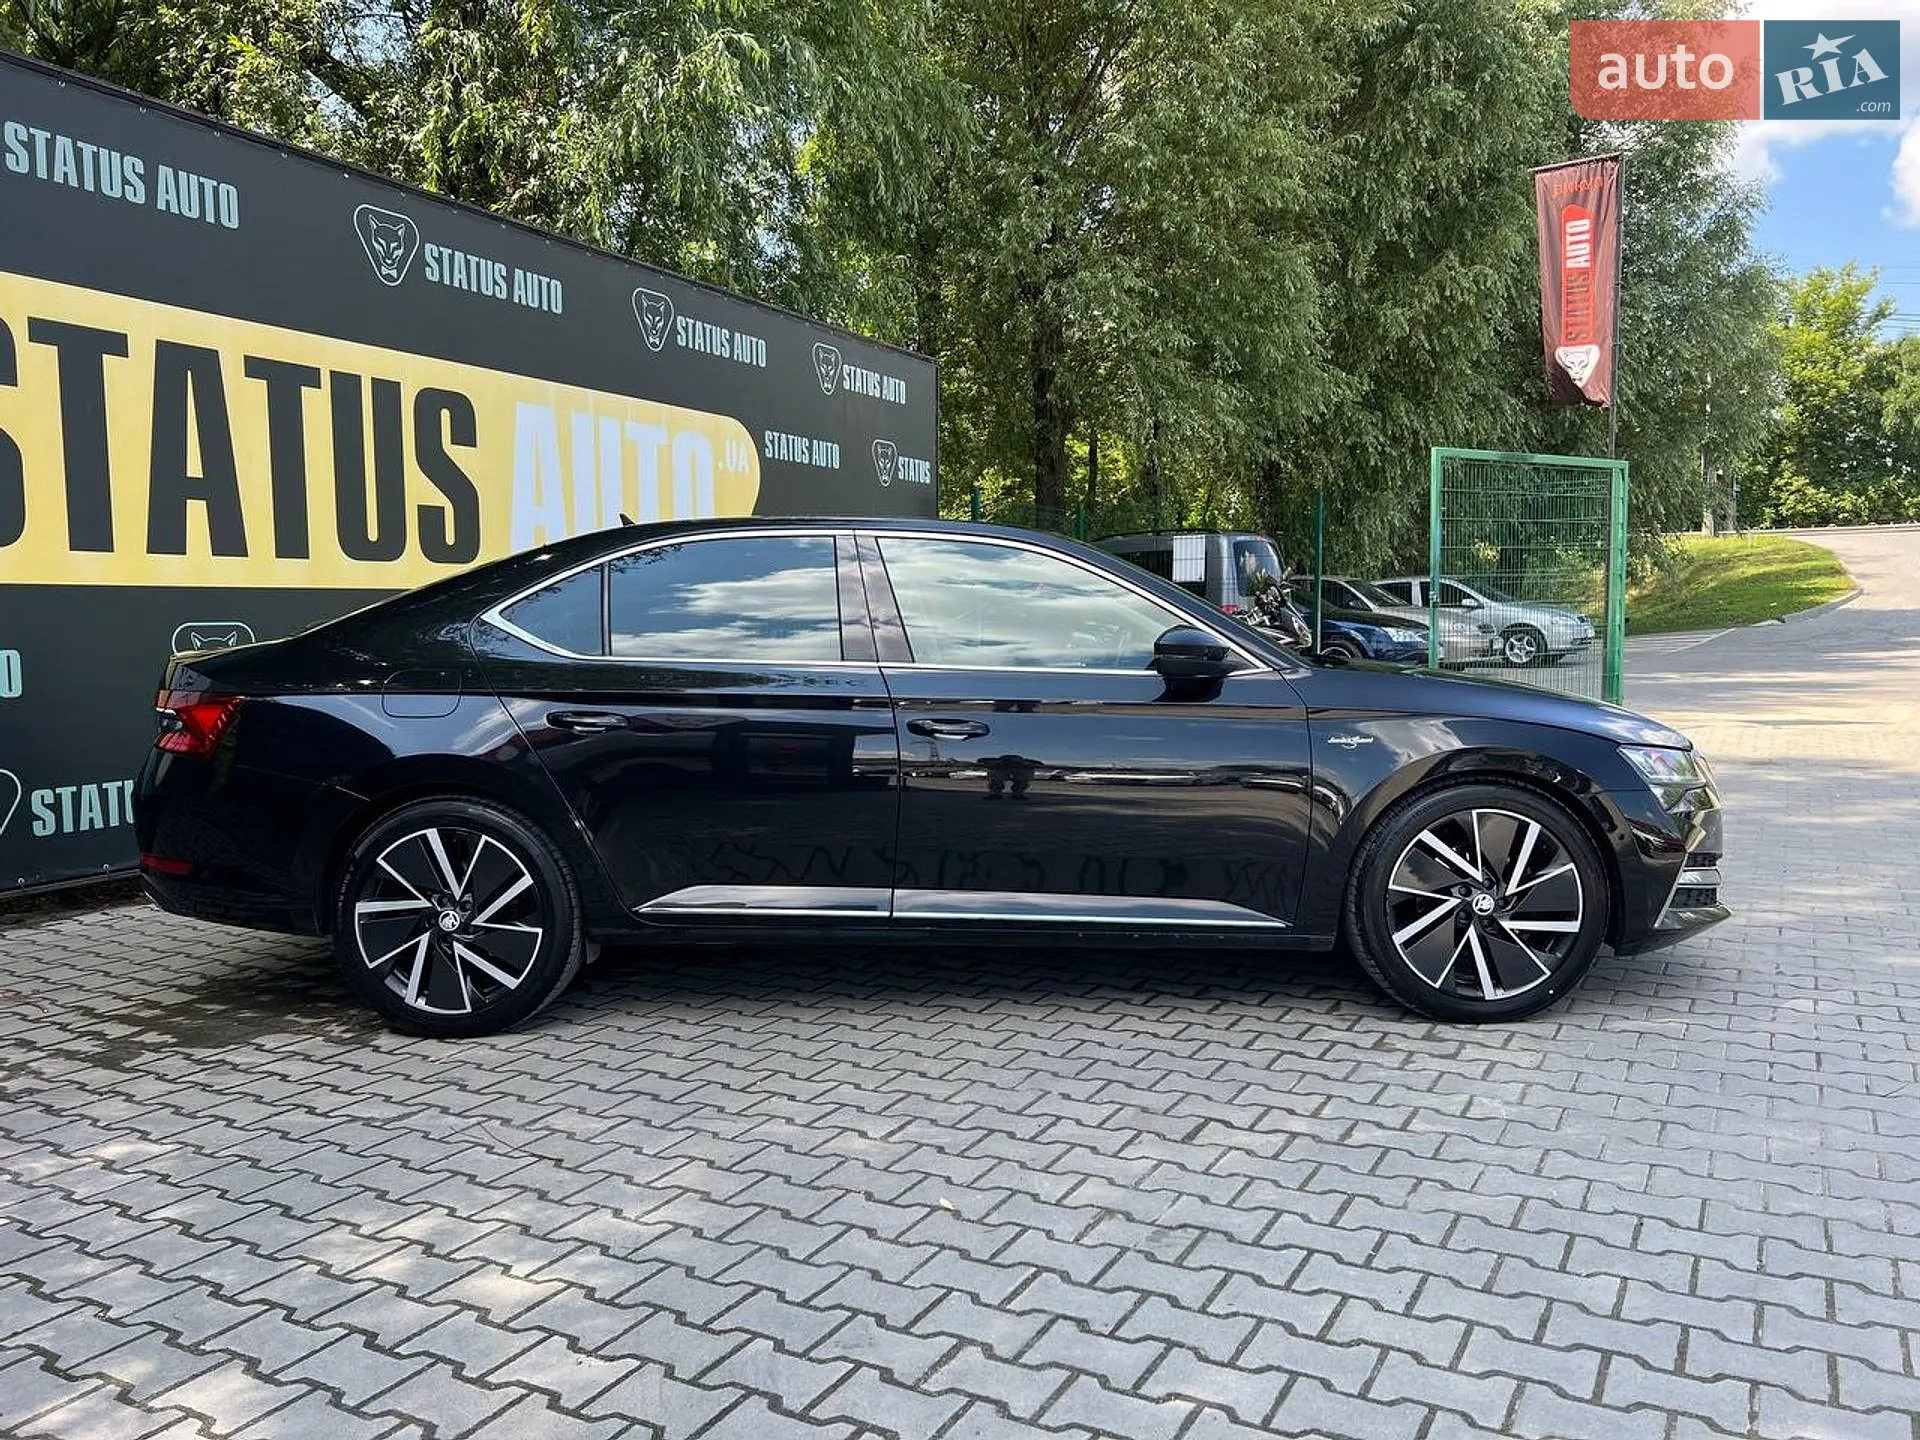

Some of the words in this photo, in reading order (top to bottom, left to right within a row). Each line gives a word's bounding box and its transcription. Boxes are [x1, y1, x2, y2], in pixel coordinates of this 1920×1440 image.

[4, 121, 146, 204] STATUS
[157, 165, 239, 230] AUTO
[1566, 219, 1591, 269] AUTO
[424, 243, 507, 299] STATUS
[513, 269, 563, 315] AUTO
[676, 315, 731, 356] STATUS
[733, 333, 767, 368] AUTO
[842, 364, 880, 398] STATUS
[882, 377, 906, 404] AUTO
[765, 430, 810, 464] STATUS
[811, 438, 840, 470] AUTO
[898, 456, 931, 484] STATUS
